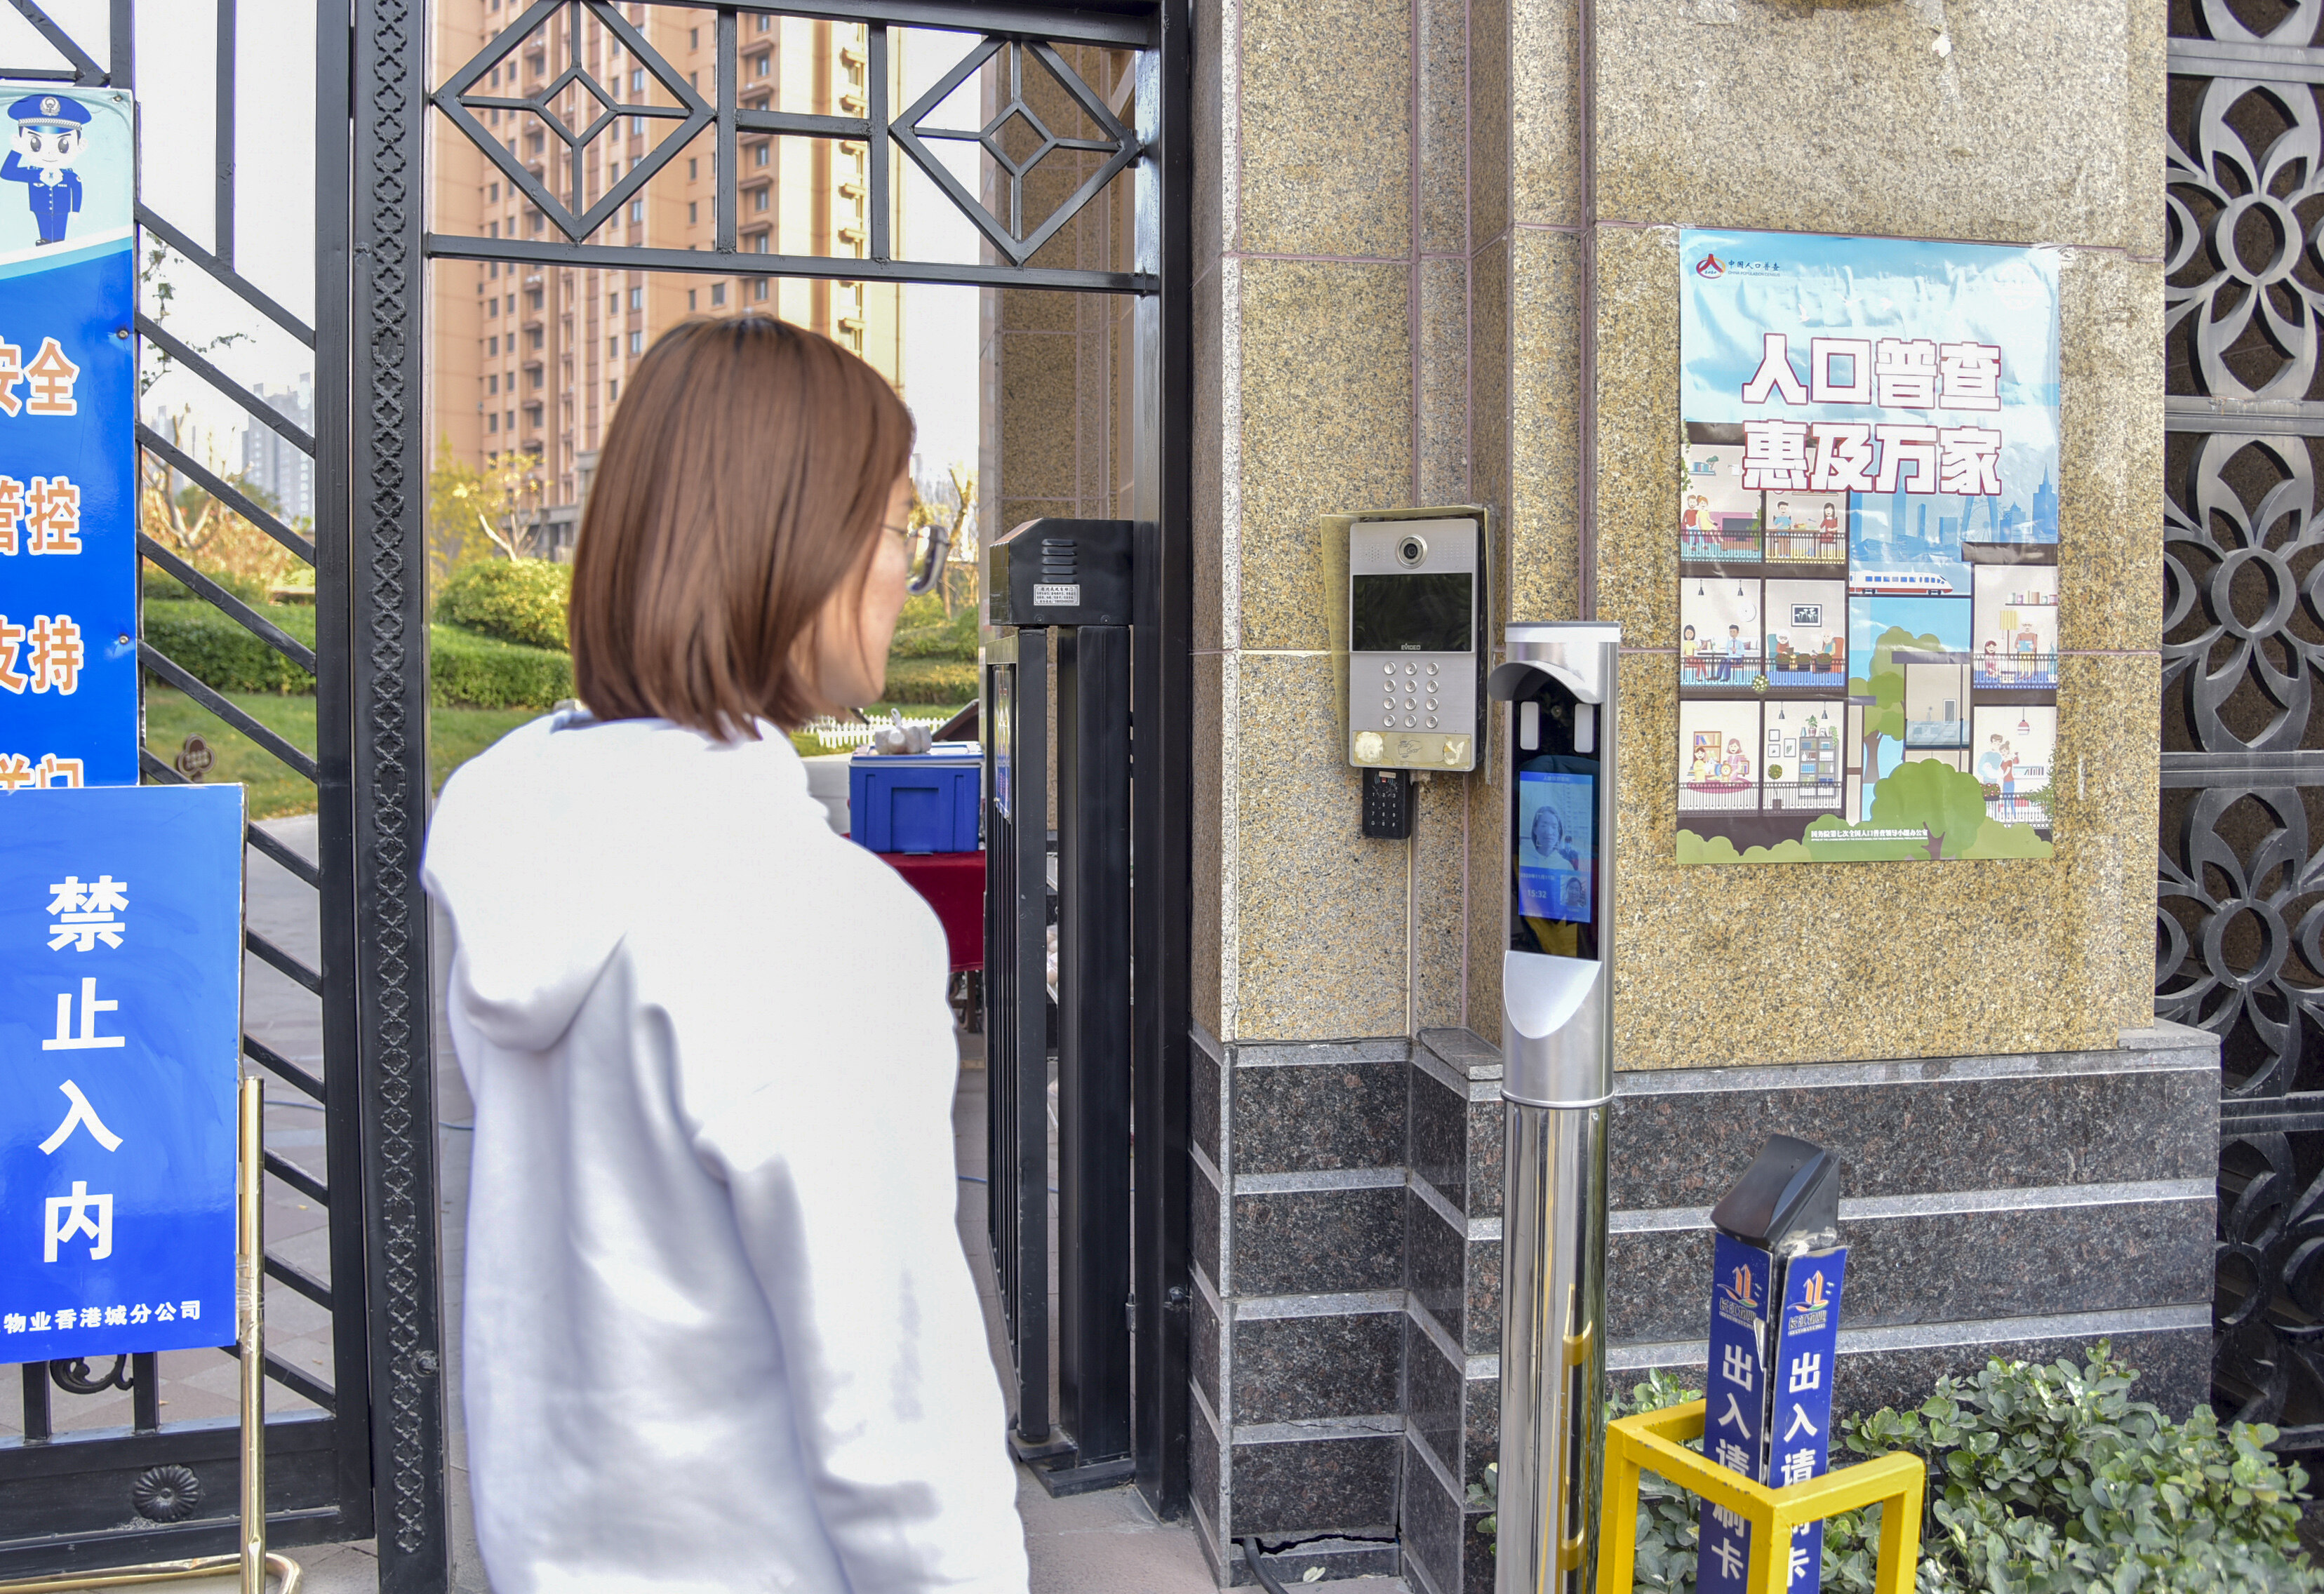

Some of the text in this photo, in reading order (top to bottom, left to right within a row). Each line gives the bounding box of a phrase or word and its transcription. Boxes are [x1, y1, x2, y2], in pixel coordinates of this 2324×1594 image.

[1728, 260, 1780, 272] 中国人口普查
[1742, 333, 2001, 411] 人口普查
[1742, 419, 2002, 496] 惠及万家
[1528, 889, 1547, 899] 15:32
[38, 874, 129, 1264] 禁止入内
[4, 1300, 201, 1334] 物业香港城分公司
[1788, 1309, 1827, 1330] 长江物业
[1780, 1352, 1821, 1587] 出入请卡
